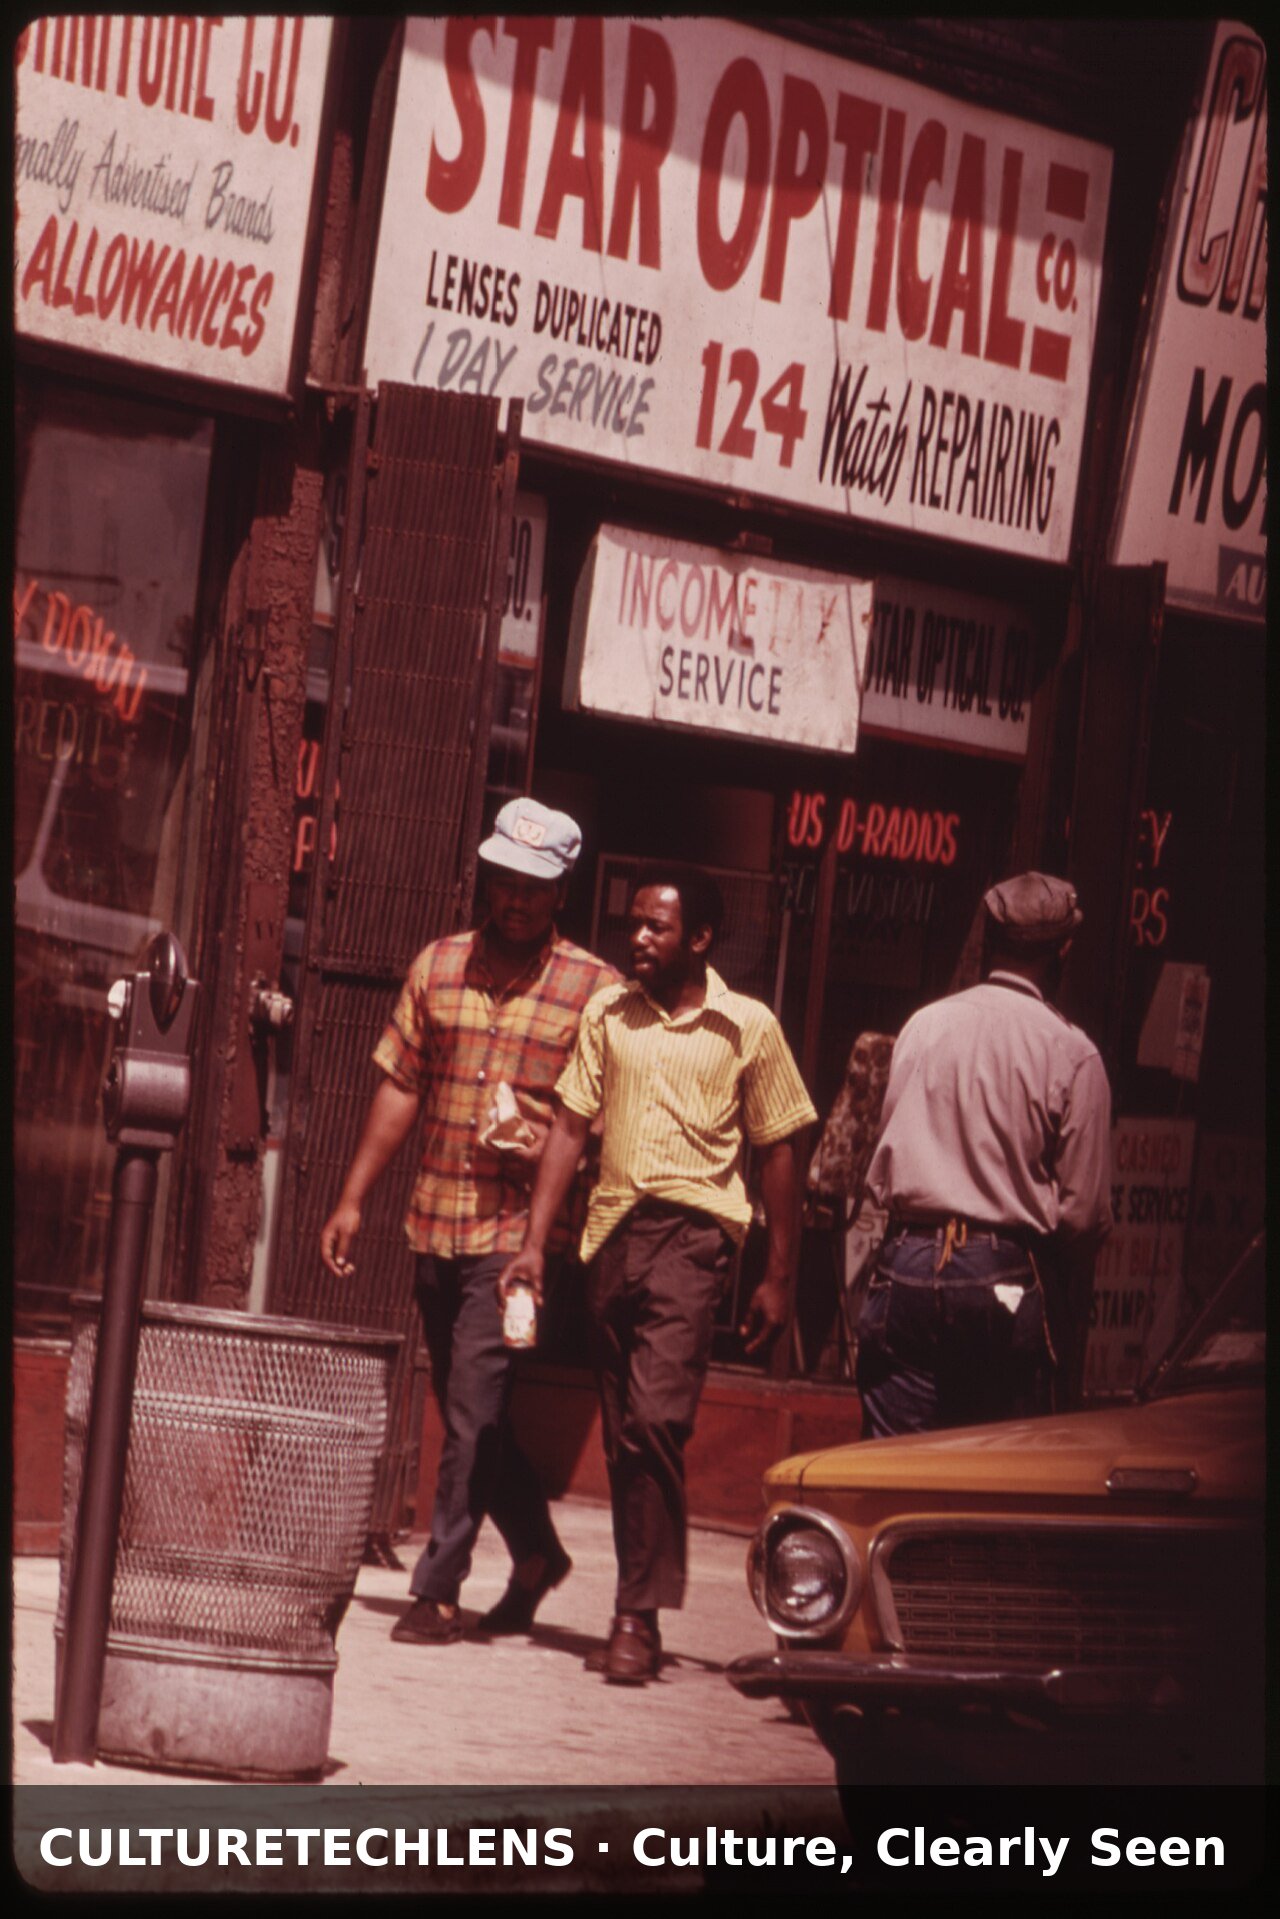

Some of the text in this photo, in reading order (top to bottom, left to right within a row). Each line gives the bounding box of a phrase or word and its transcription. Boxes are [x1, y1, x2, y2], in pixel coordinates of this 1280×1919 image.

[89, 131, 198, 225] Advertised
[205, 161, 275, 244] Brands
[425, 16, 1078, 371] STAR OPTICAL CO.
[22, 214, 275, 357] ALLOWANCES
[425, 250, 663, 366] LENSES DUPLICATED
[437, 328, 518, 396] DAY
[527, 353, 656, 437] SERVICE
[695, 340, 808, 469] 124
[819, 357, 1061, 535] Watch REPAIRING
[1168, 366, 1267, 536] MO
[43, 590, 148, 722] DOWN
[618, 551, 758, 649] INCOME
[659, 645, 784, 716] SERVICE
[864, 599, 1031, 722] STAR OPTICAL CO.
[1117, 1133, 1182, 1173] CASHED
[1128, 1184, 1188, 1223] SERVICE
